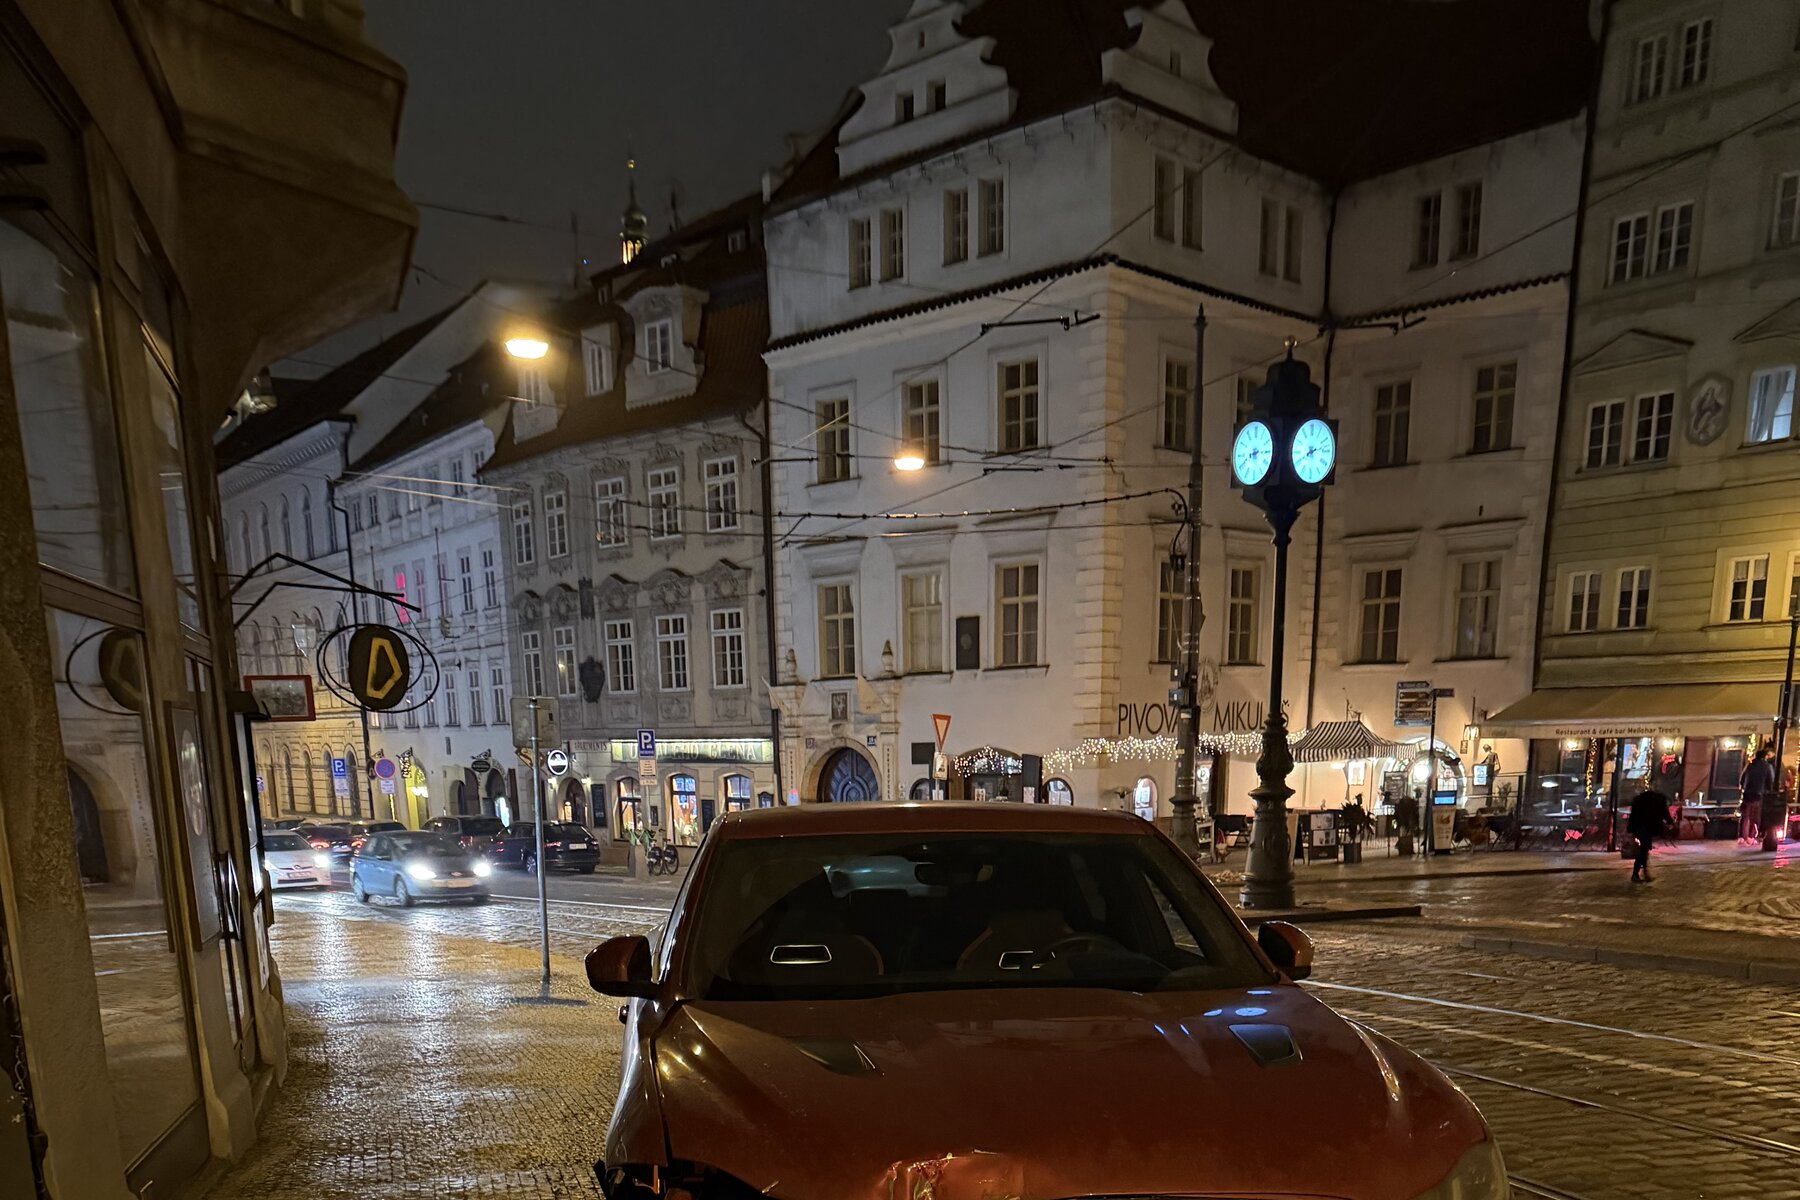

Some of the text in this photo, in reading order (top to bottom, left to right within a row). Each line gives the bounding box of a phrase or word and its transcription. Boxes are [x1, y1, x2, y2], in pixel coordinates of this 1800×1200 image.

[1213, 699, 1290, 733] MIKULŠ
[1555, 728, 1591, 736] Restaurant
[1615, 727, 1626, 735] bar
